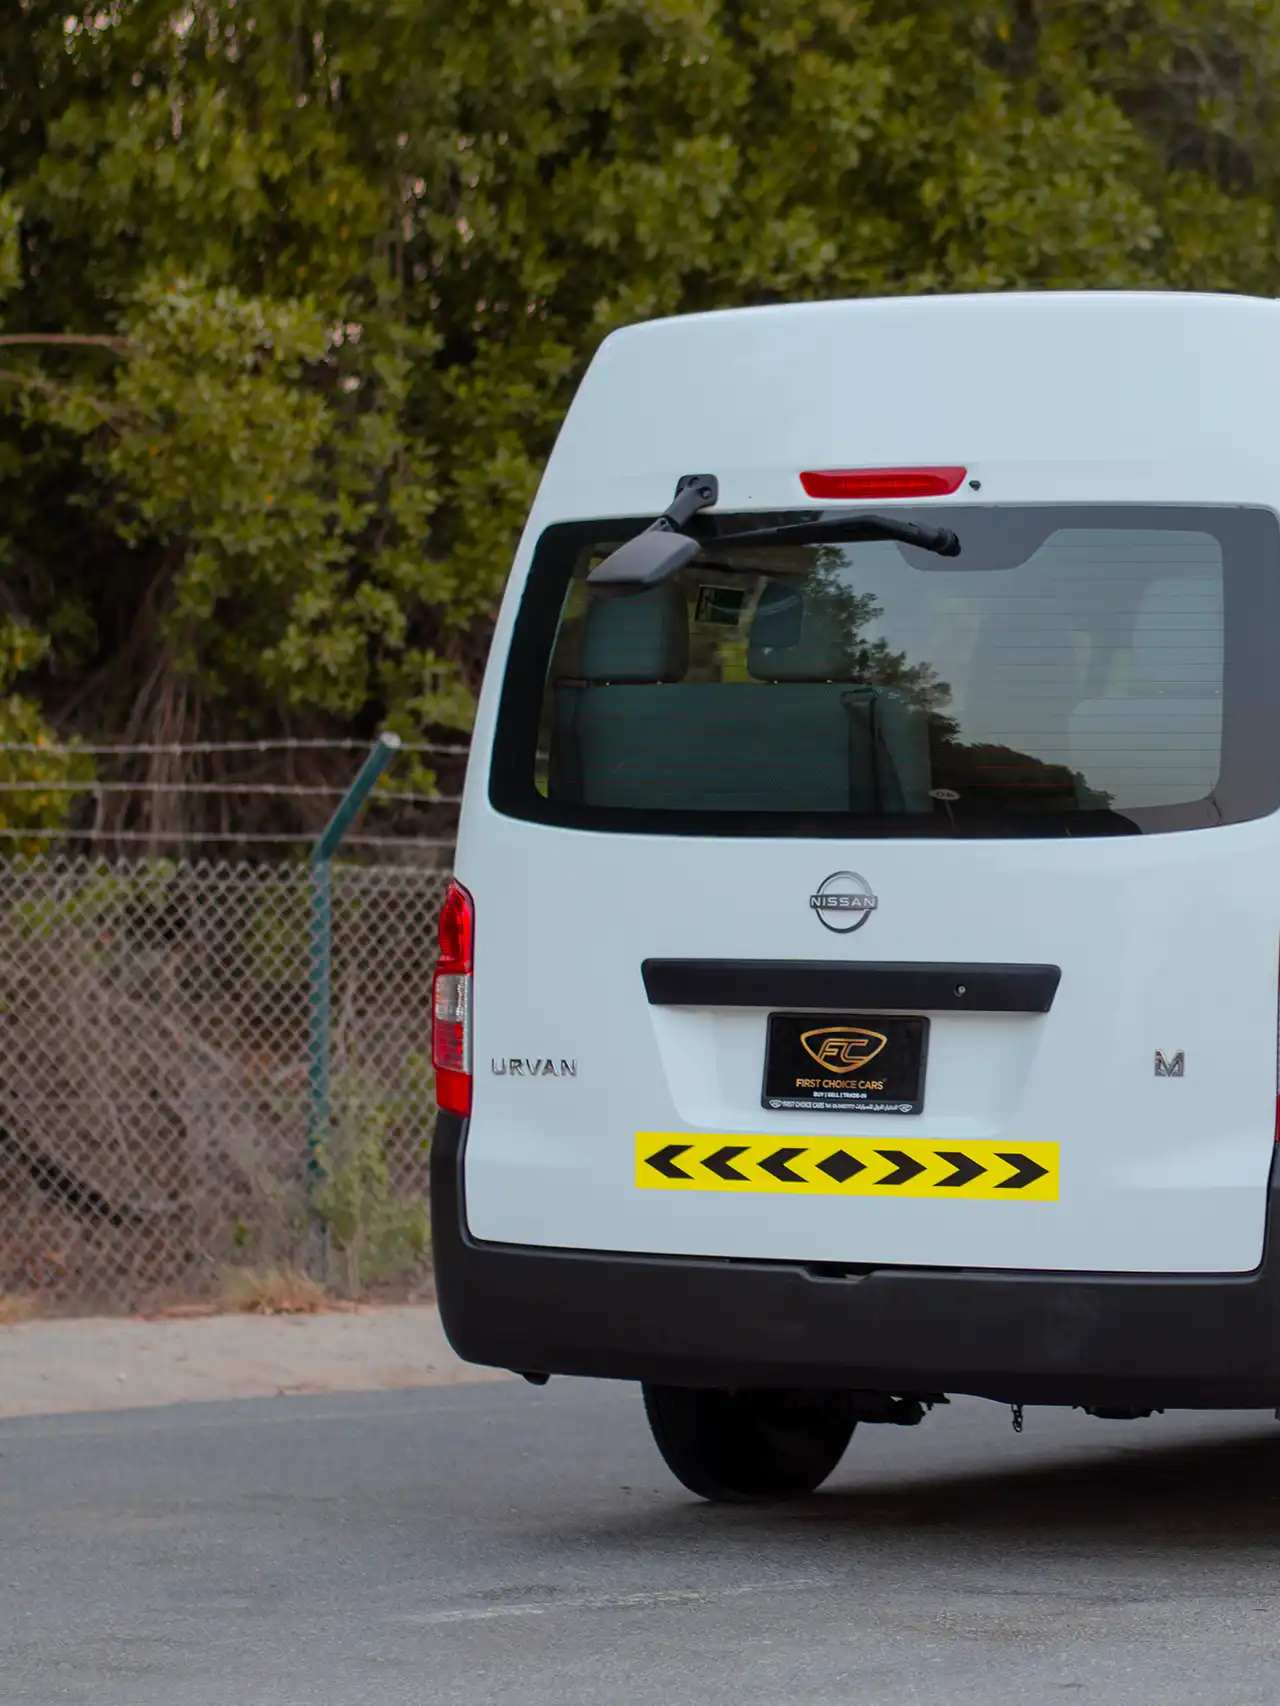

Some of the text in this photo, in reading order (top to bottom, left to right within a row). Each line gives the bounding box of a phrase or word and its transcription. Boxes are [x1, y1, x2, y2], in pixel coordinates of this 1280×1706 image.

[810, 896, 876, 907] NISSAN
[491, 1057, 578, 1077] URVAN
[795, 1078, 884, 1090] FIRST CHOICE CARS
[782, 1100, 795, 1108] FIRST
